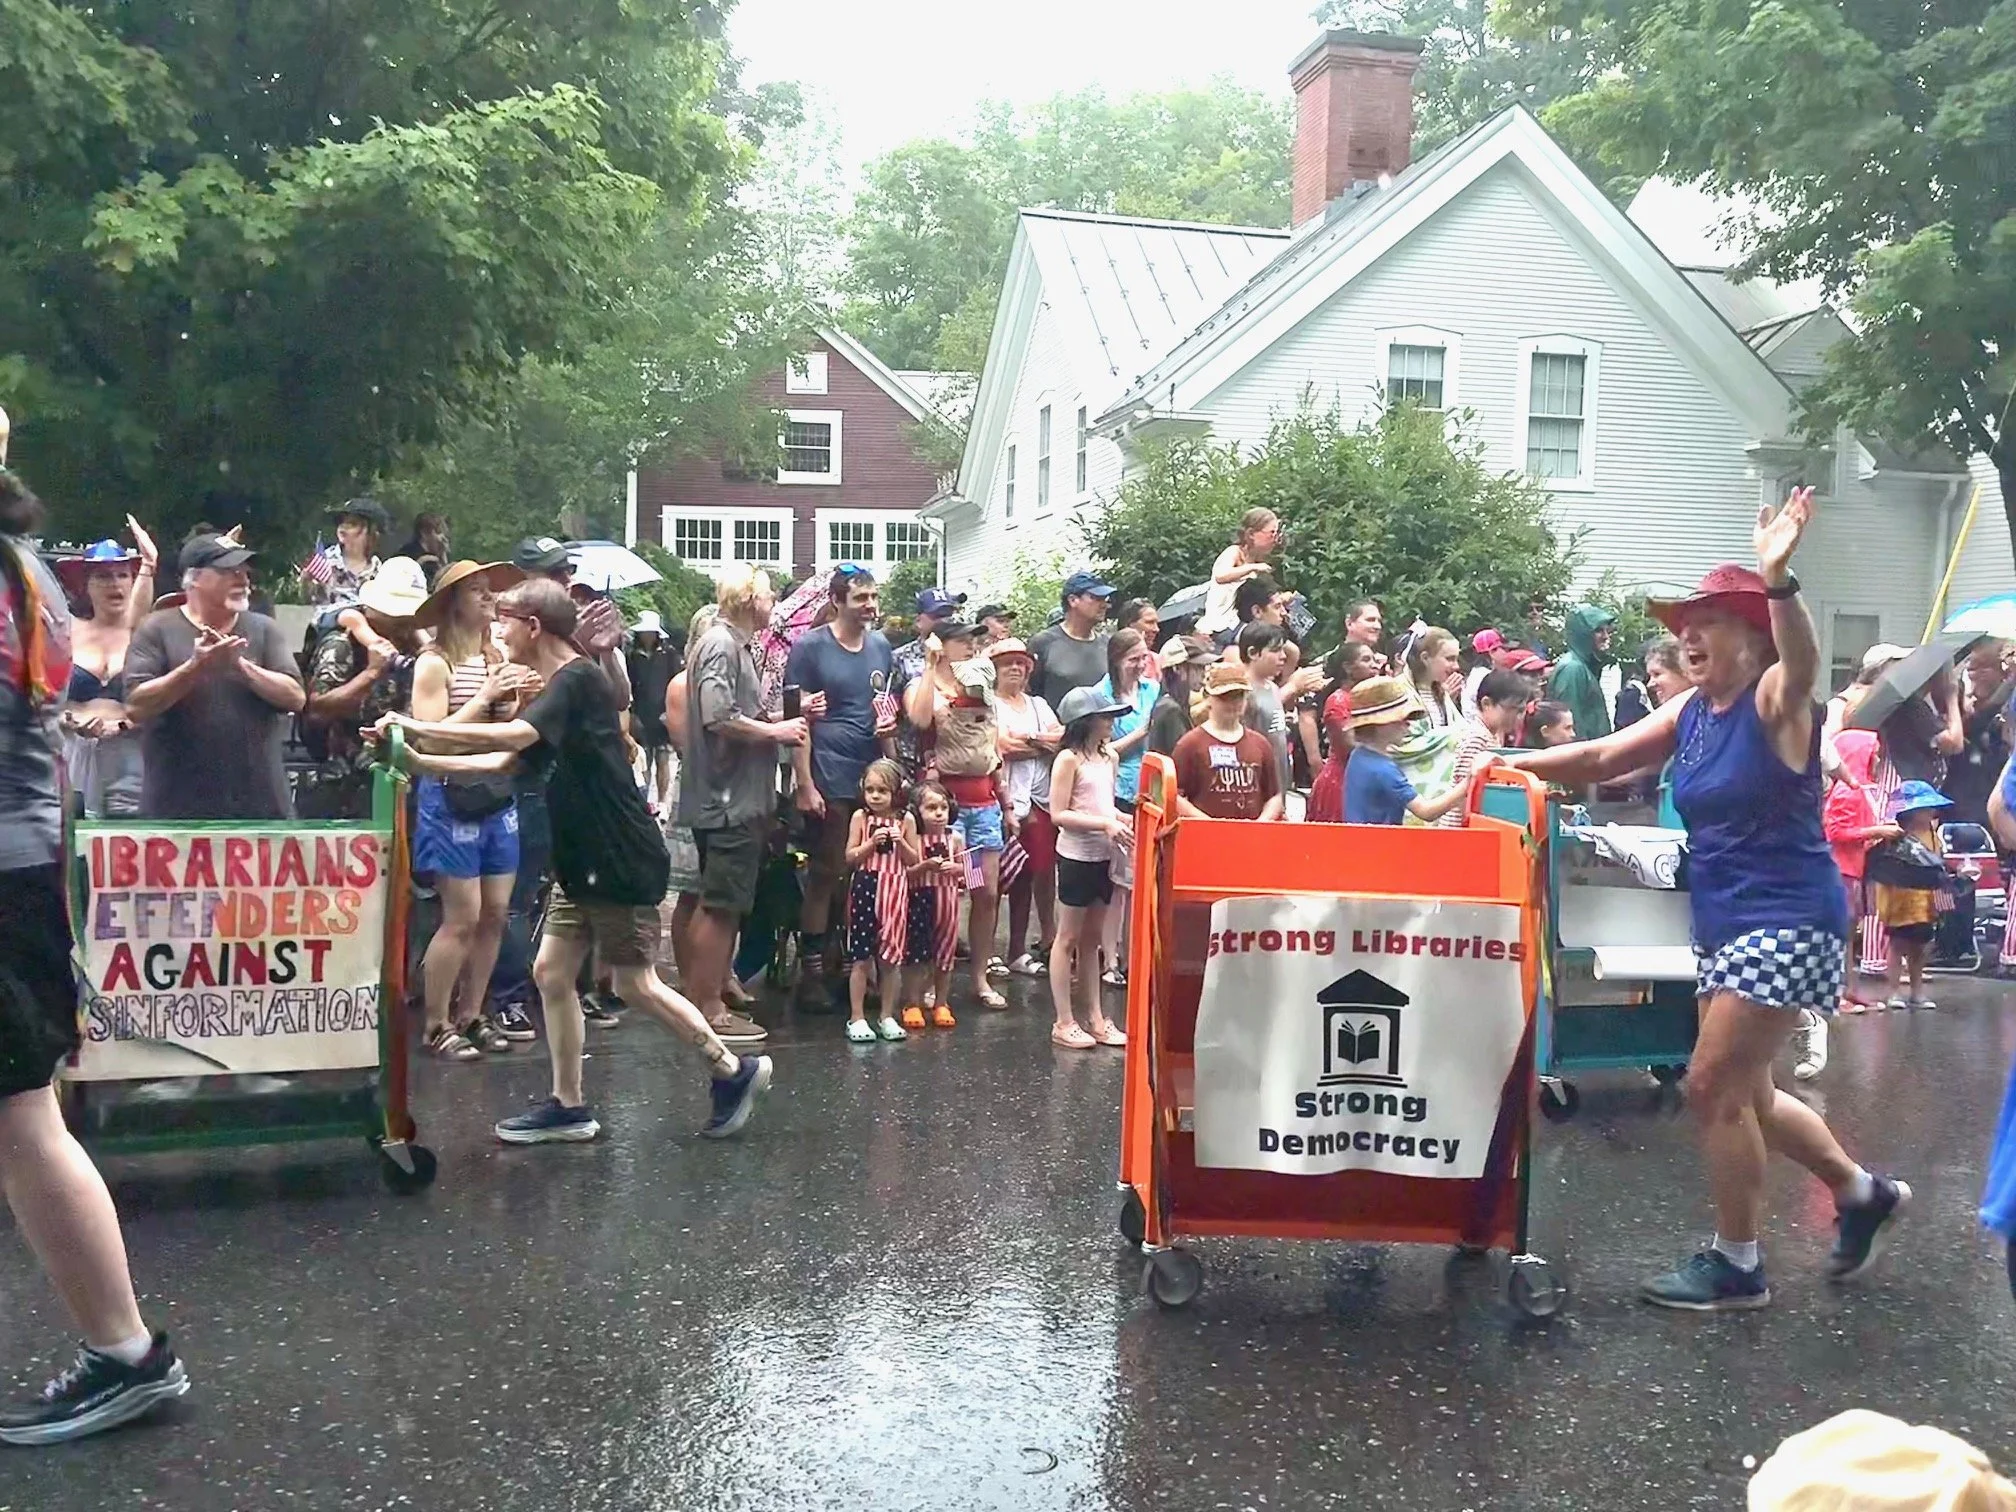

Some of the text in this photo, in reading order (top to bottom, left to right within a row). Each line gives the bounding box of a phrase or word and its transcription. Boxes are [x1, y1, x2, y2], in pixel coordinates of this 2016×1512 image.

[94, 889, 362, 940] EFENDERS
[101, 939, 332, 991] AGAINST
[1352, 930, 1527, 962] Libraries
[88, 983, 380, 1042] SINFORMATION
[1295, 1091, 1427, 1122] Strong
[1258, 1127, 1461, 1164] Democracy
